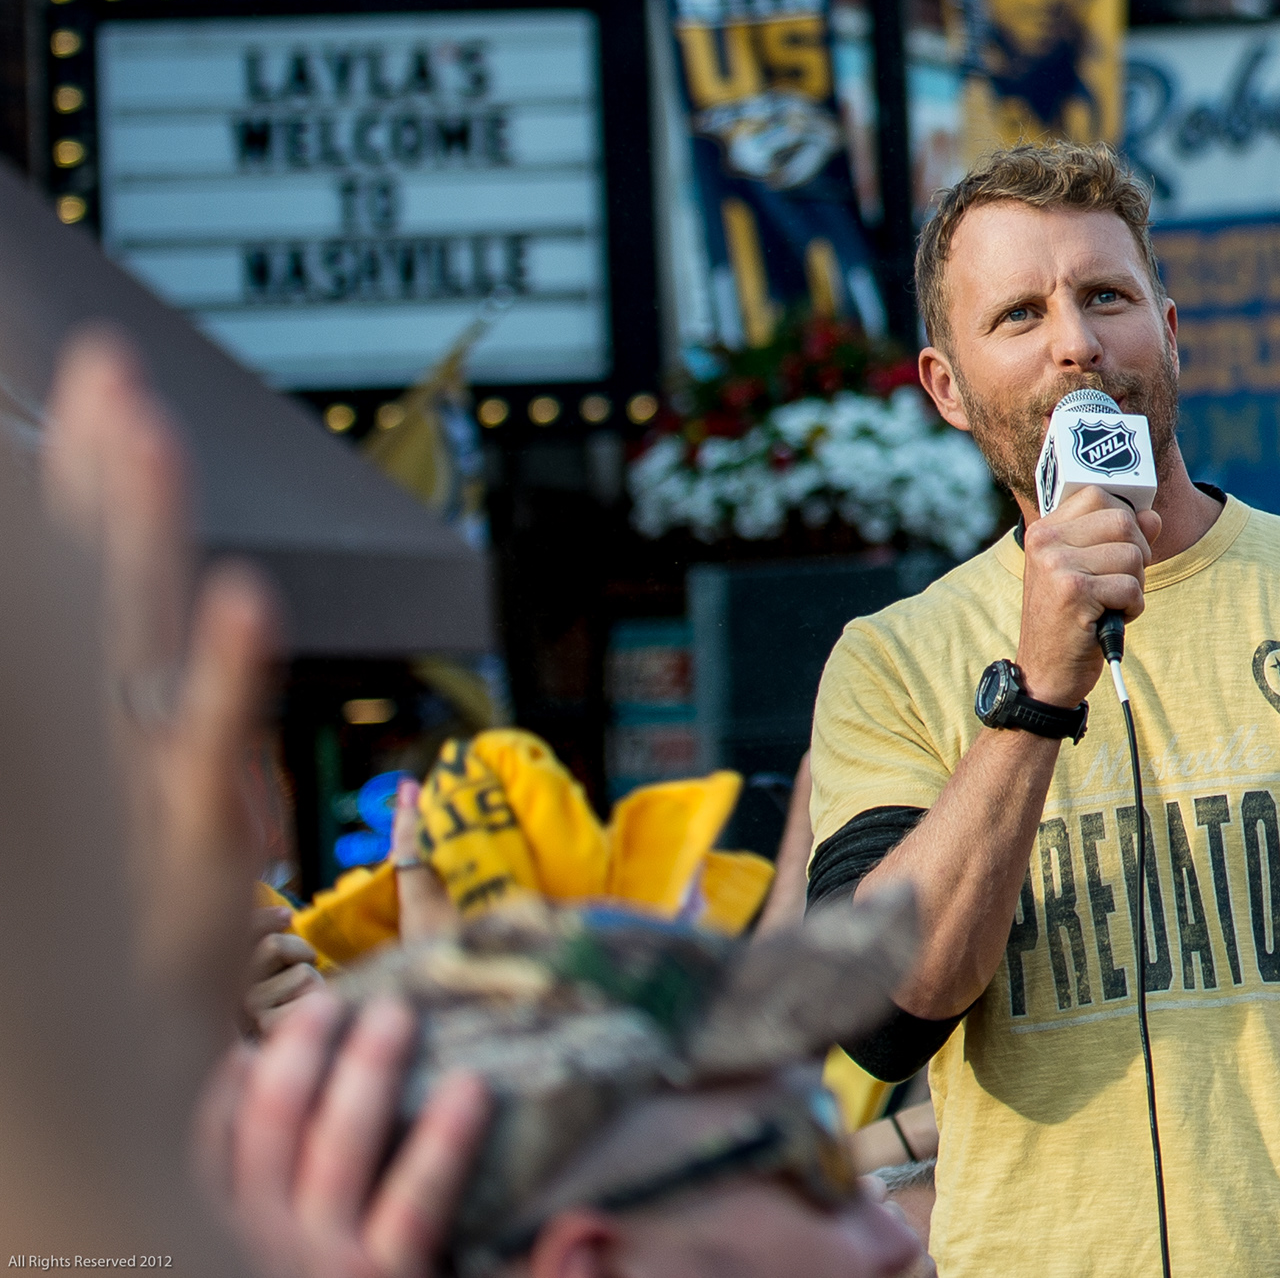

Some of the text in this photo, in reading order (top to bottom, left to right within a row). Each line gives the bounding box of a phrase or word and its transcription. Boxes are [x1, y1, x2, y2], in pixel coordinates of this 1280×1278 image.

[245, 38, 492, 102] LAYLA'S
[678, 16, 834, 110] US
[232, 106, 514, 169] WELCOME
[335, 175, 403, 236] TO
[243, 235, 530, 300] NASHVILLE
[1088, 436, 1125, 464] NHL
[1076, 724, 1275, 790] Nashville
